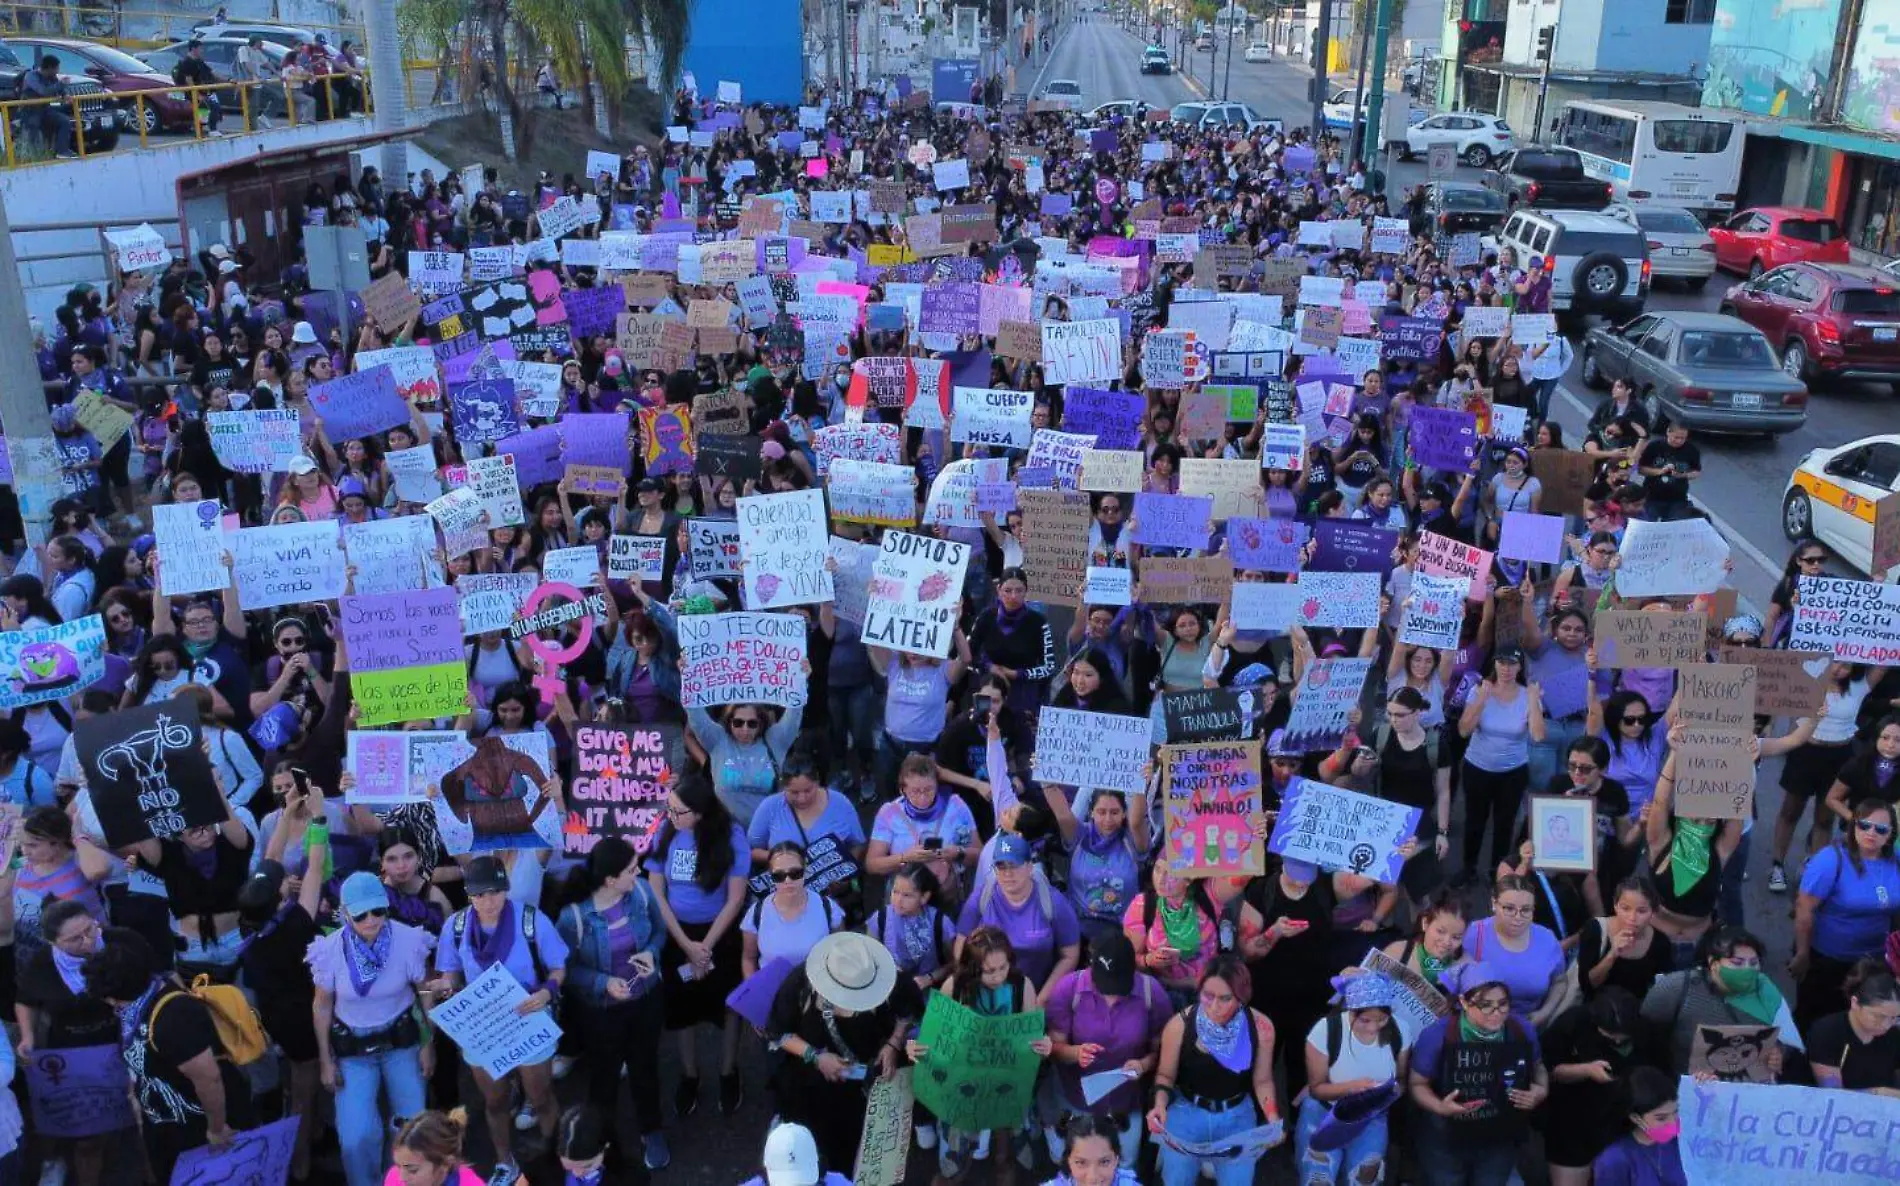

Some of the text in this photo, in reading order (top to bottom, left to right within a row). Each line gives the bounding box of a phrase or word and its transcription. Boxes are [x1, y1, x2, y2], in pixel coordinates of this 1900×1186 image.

[968, 431, 1013, 444] MUSA
[275, 545, 312, 562] VIVA
[611, 538, 630, 555] NO
[883, 531, 963, 566] SOMOS
[1434, 535, 1450, 552] UN
[1467, 549, 1481, 566] NO
[1799, 593, 1860, 609] vestida
[1831, 579, 1883, 601] estoy
[347, 599, 397, 624] Somos
[403, 600, 424, 620] las
[930, 609, 949, 624] NO
[348, 628, 373, 650] que
[419, 624, 439, 638] se
[680, 616, 711, 640] NO
[724, 615, 754, 637] TE
[865, 612, 938, 652] LATEN
[725, 638, 750, 655] ME
[753, 640, 801, 661] DOLIO
[682, 656, 790, 682] SABER QUE YA
[359, 677, 382, 699] las
[424, 675, 444, 695] de
[684, 670, 752, 694] NO ESTAS
[1681, 674, 1741, 702] MARCHO
[696, 689, 719, 706] NI
[722, 685, 758, 703] UNA
[360, 698, 386, 718] que
[1196, 745, 1247, 761] CANSAS
[1072, 768, 1083, 782] A
[1170, 773, 1249, 790] NOSOTRAS
[139, 788, 181, 810] NO
[1170, 789, 1188, 801] DE
[586, 808, 608, 828] IT
[1304, 803, 1322, 819] NO
[147, 813, 188, 840] NO
[1299, 820, 1317, 836] NO
[1293, 835, 1312, 850] NO
[440, 976, 502, 1024] ELLA ERA
[491, 1027, 555, 1073] ALGUIEN
[966, 1048, 1018, 1066] ESTAN
[1456, 1050, 1492, 1070] HOY
[1694, 1087, 1874, 1143] Y la culpa
[1780, 1142, 1809, 1169] ni
